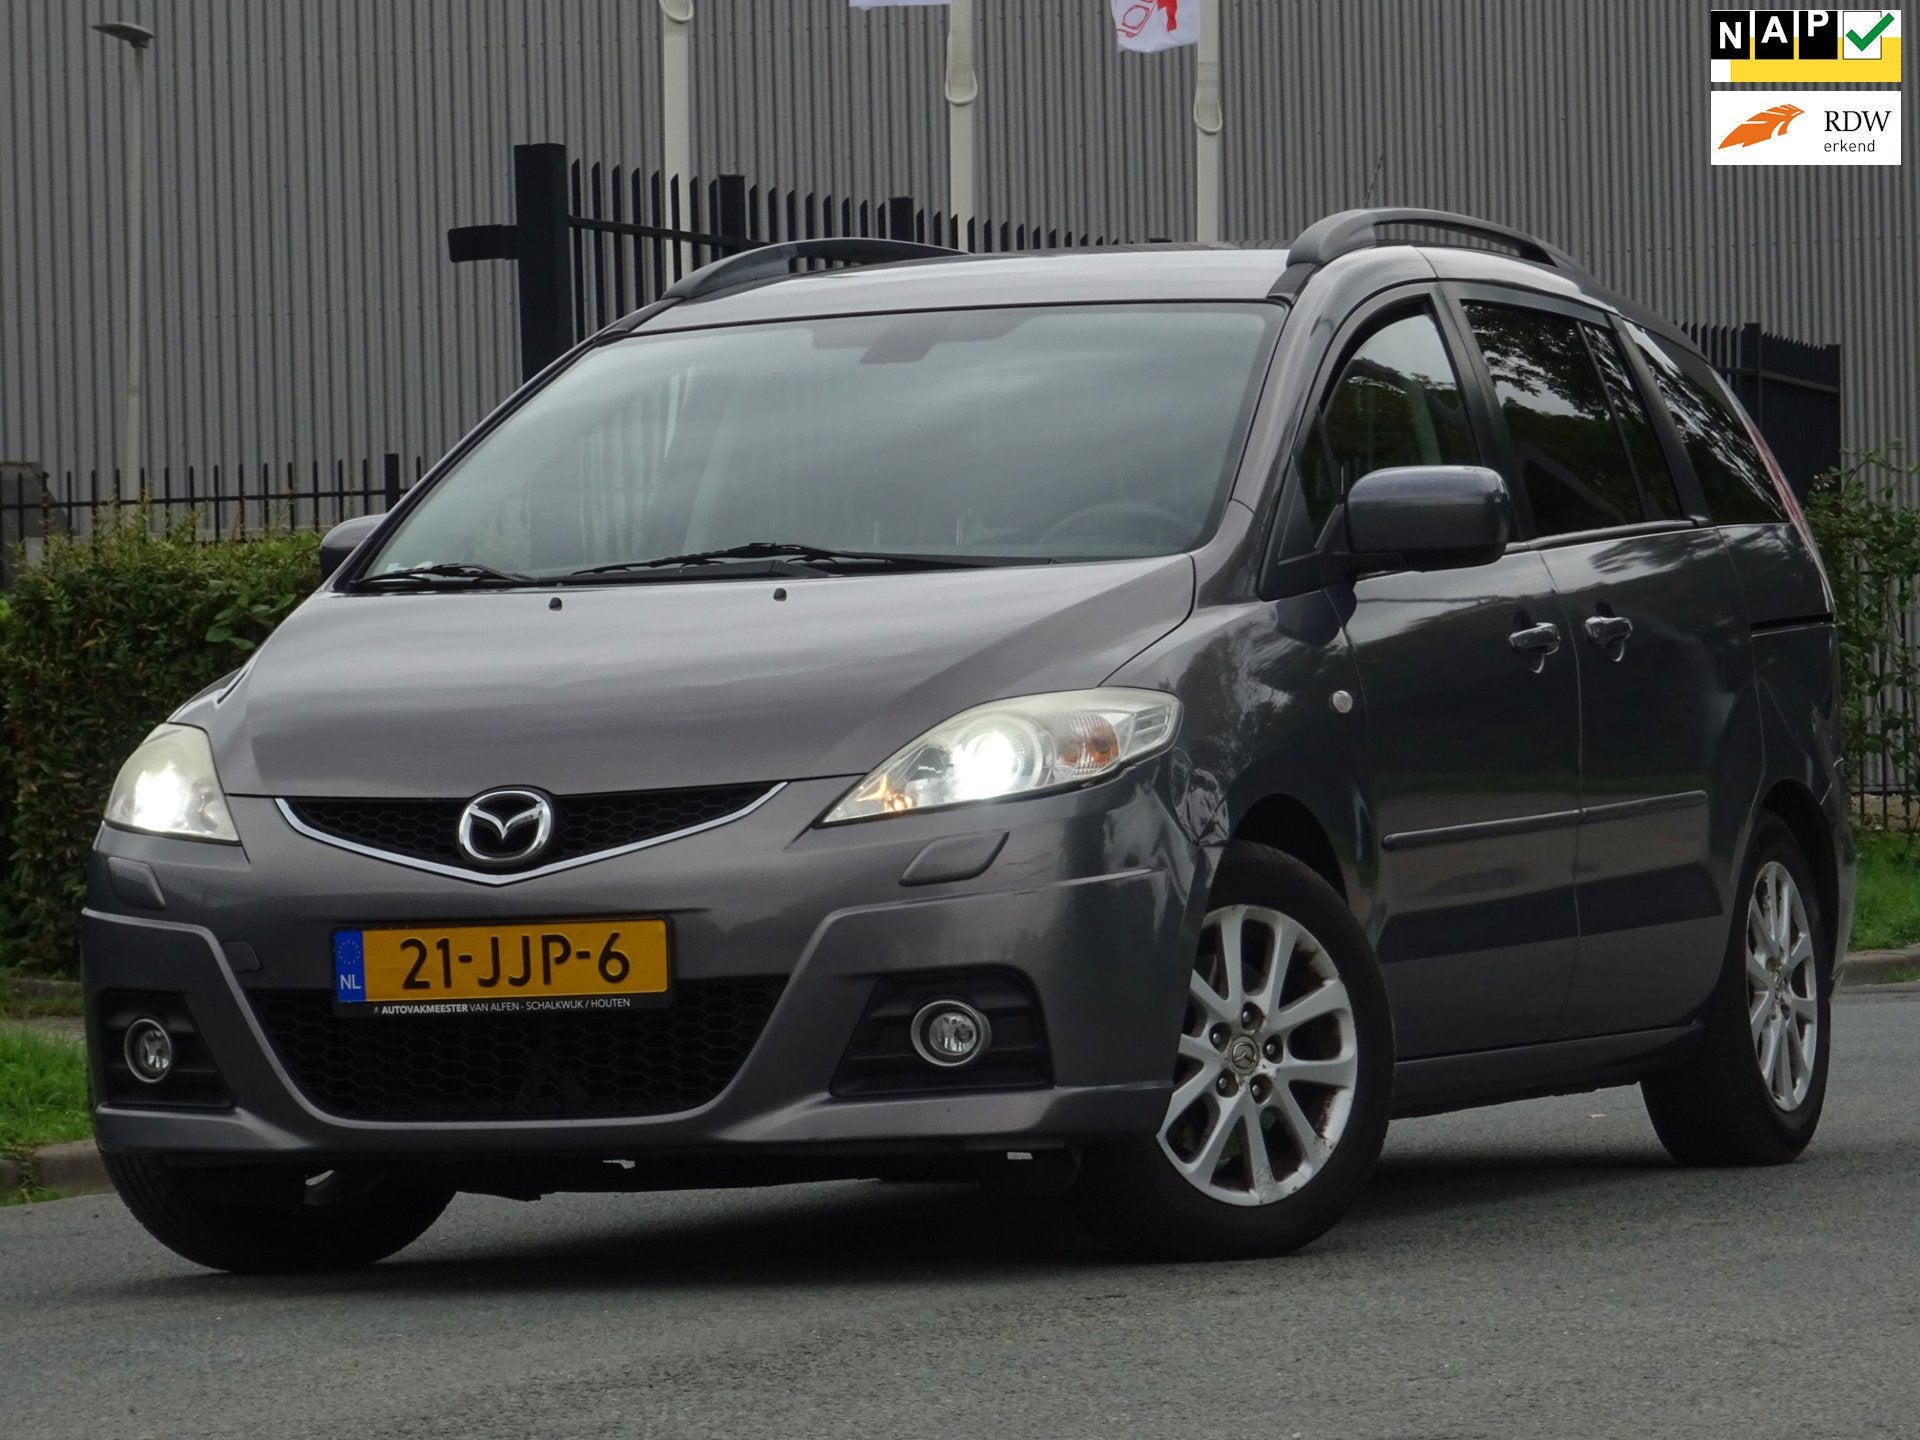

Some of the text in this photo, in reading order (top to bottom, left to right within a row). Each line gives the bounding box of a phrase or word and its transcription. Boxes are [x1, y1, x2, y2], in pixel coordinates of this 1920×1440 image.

[400, 932, 630, 990] 21-JJP-6
[340, 974, 361, 991] NL
[381, 1003, 468, 1015] AUTOVAKMEESTER
[469, 1003, 488, 1012] VAN
[490, 1001, 519, 1012] ALFEN
[526, 1000, 584, 1011] SCHALKWIJK
[591, 998, 631, 1008] HOUTEN
